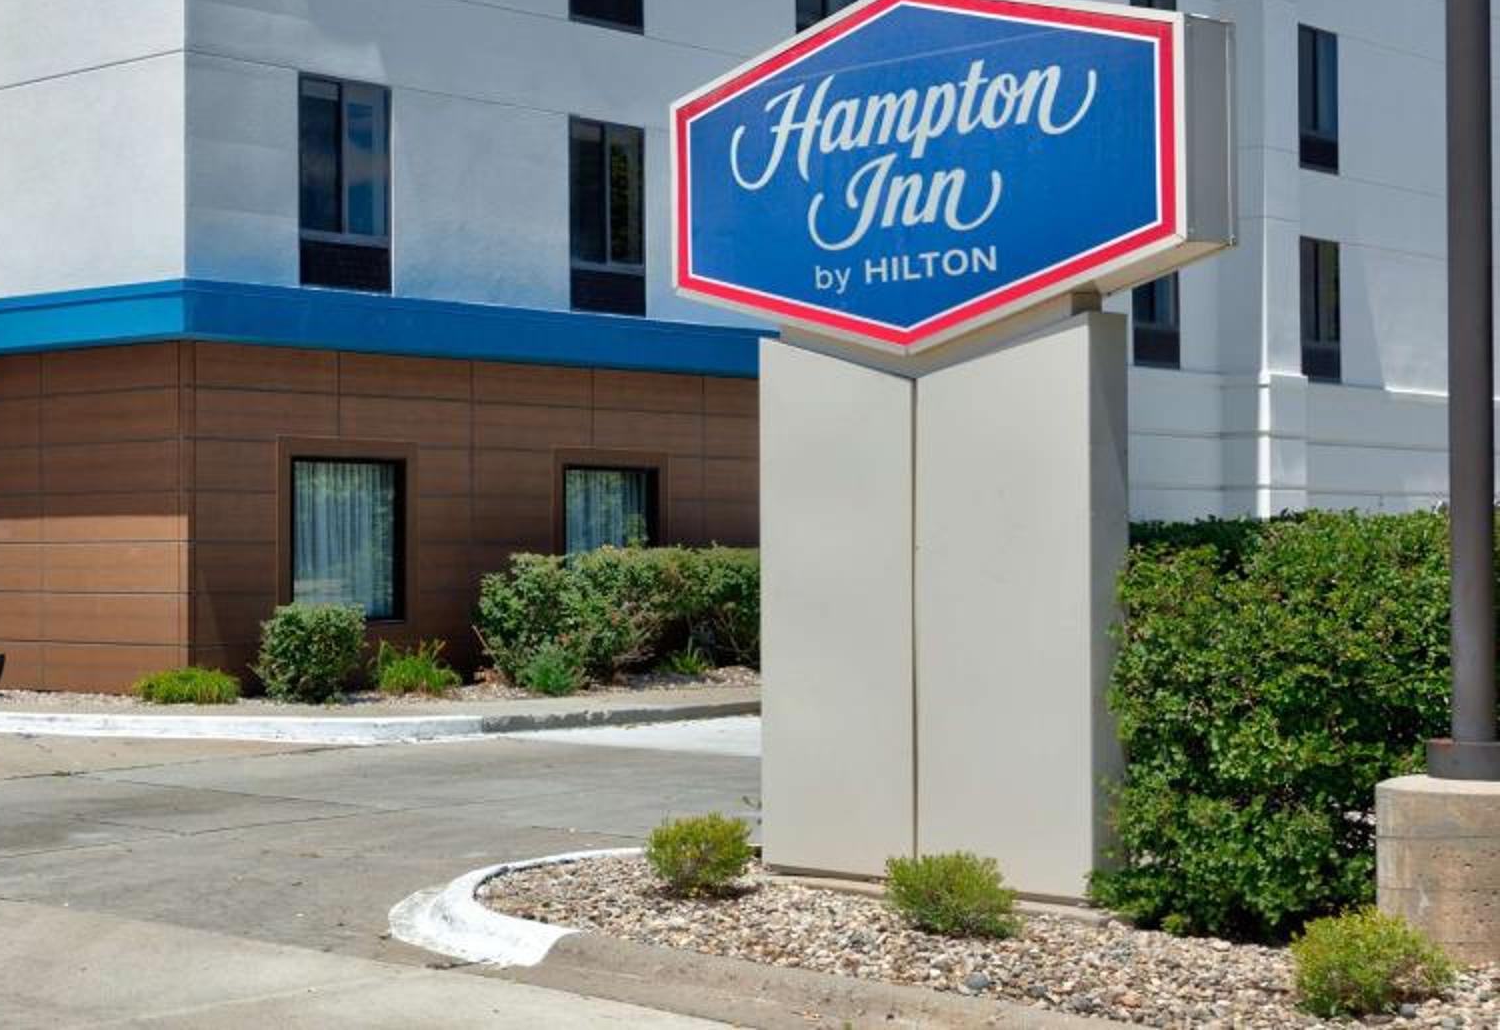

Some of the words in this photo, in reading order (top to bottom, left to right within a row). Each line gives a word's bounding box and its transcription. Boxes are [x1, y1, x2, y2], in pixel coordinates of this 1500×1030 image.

[731, 59, 1097, 191] Hampton
[809, 152, 1001, 251] Inn
[814, 265, 851, 294] by
[865, 245, 998, 284] HILTON
